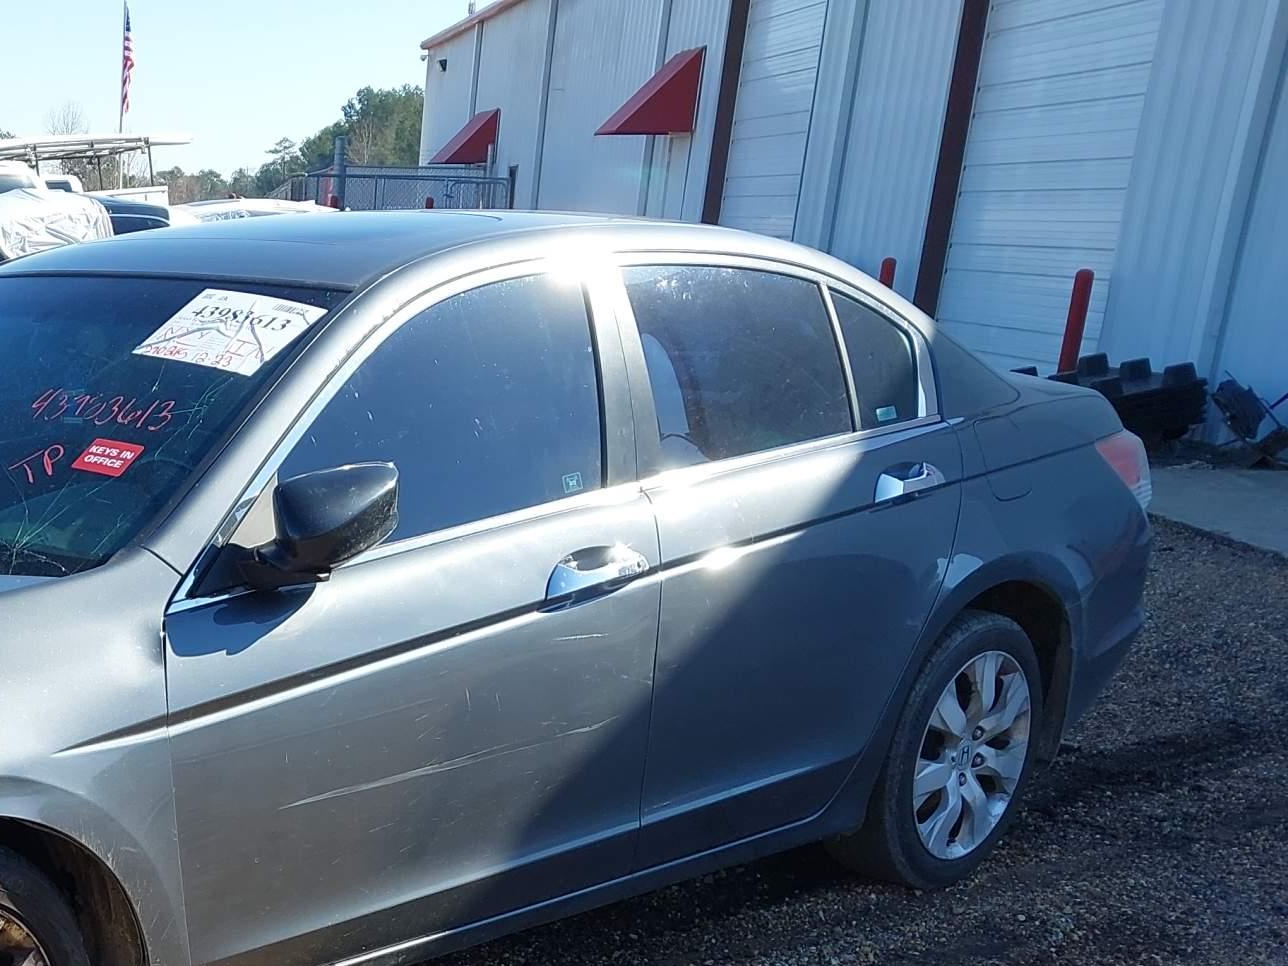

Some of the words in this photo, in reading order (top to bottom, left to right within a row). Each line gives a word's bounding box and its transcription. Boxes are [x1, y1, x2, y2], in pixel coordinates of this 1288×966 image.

[192, 304, 292, 332] 43983613
[83, 454, 125, 469] OFFICE
[88, 445, 121, 458] KEYS
[119, 450, 135, 460] IN
[8, 444, 64, 484] TP
